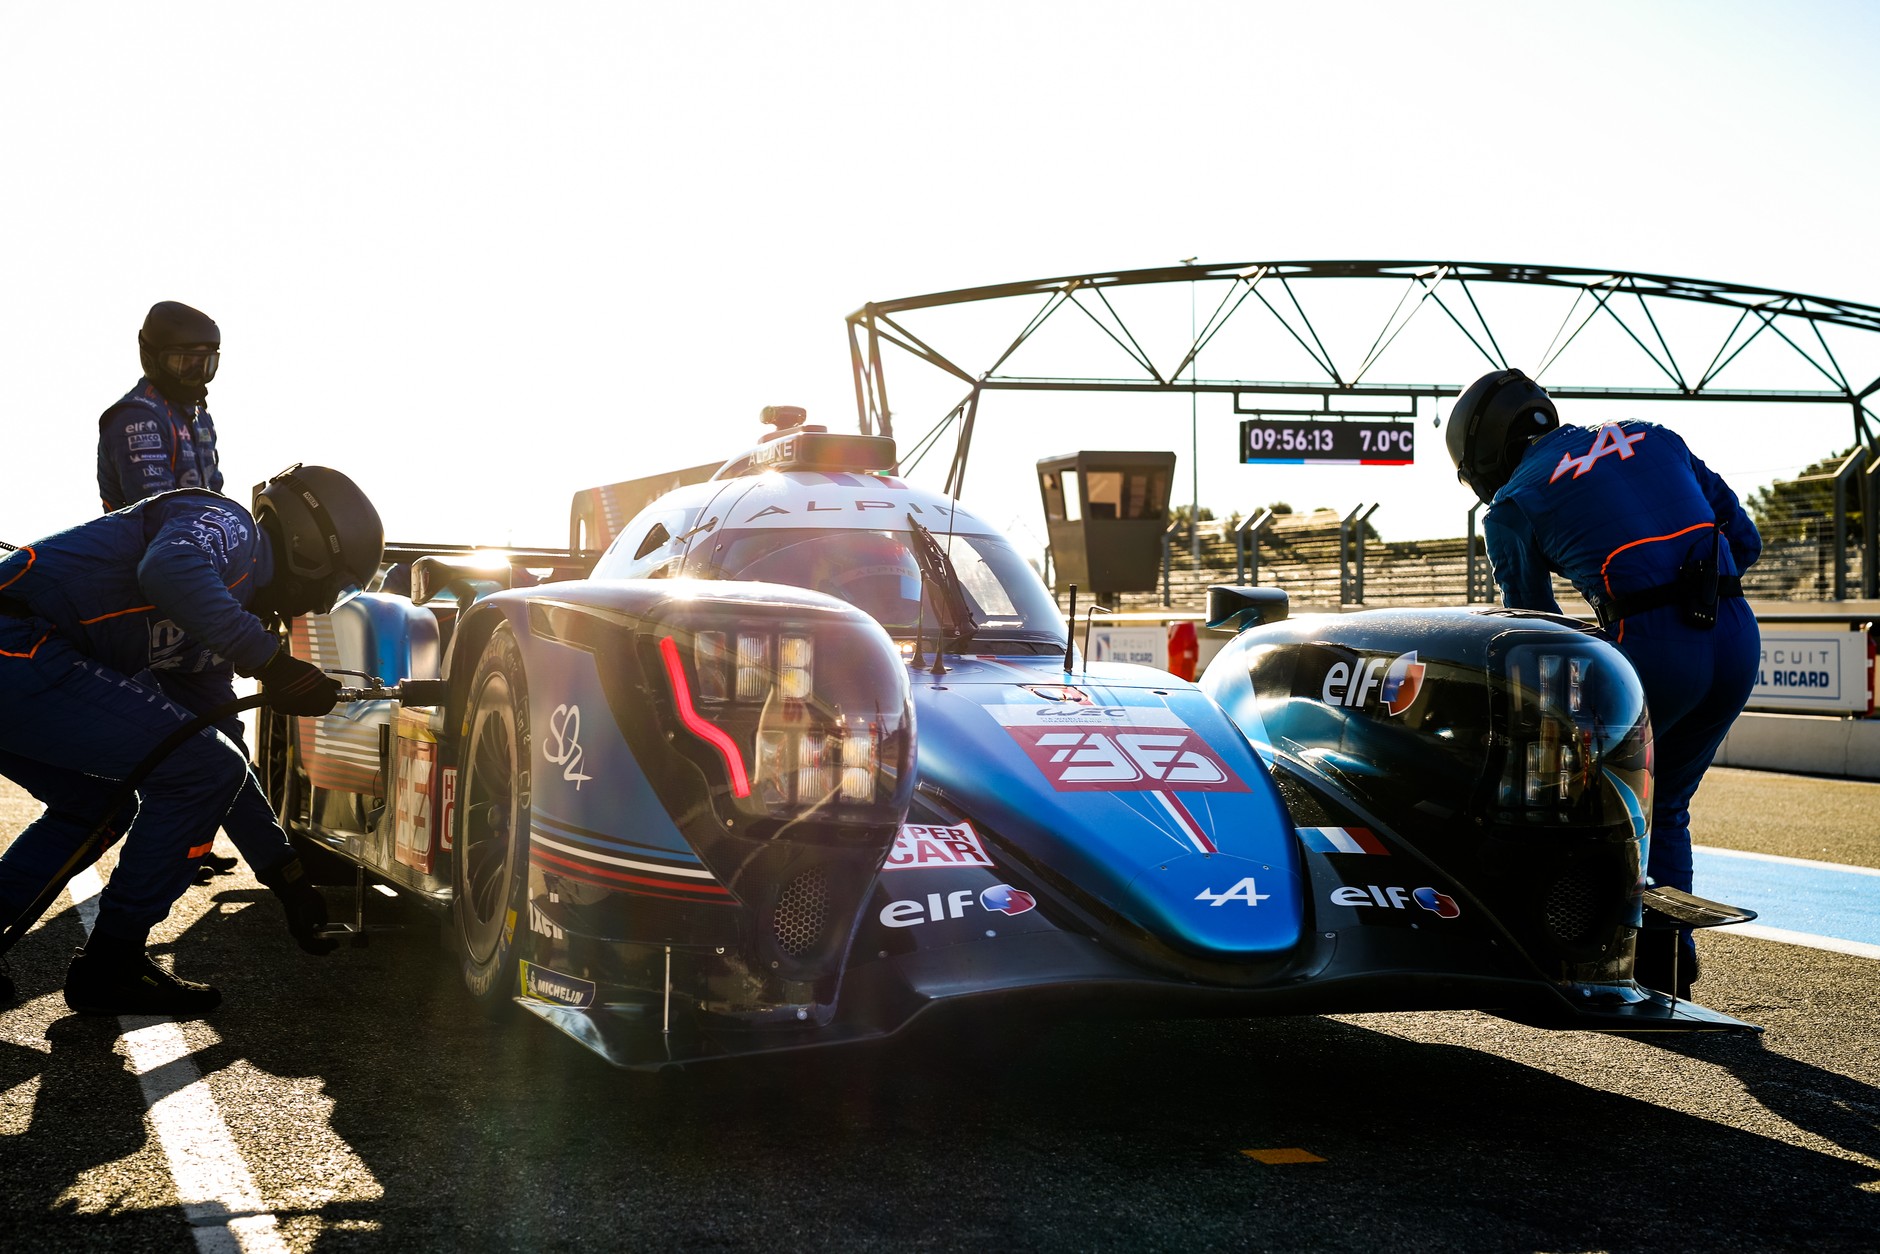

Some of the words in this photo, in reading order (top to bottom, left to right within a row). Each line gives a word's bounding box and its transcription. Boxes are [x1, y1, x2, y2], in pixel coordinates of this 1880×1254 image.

[125, 421, 146, 433] elf
[1250, 428, 1334, 451] 09:56:13
[748, 439, 793, 467] ALPINE
[1322, 657, 1386, 707] elf
[1773, 670, 1830, 688] RICARD
[1035, 733, 1229, 783] 36
[886, 840, 987, 865] CAR
[879, 890, 974, 928] elf
[1330, 885, 1410, 909] elf
[538, 979, 584, 1006] MICHELIN
